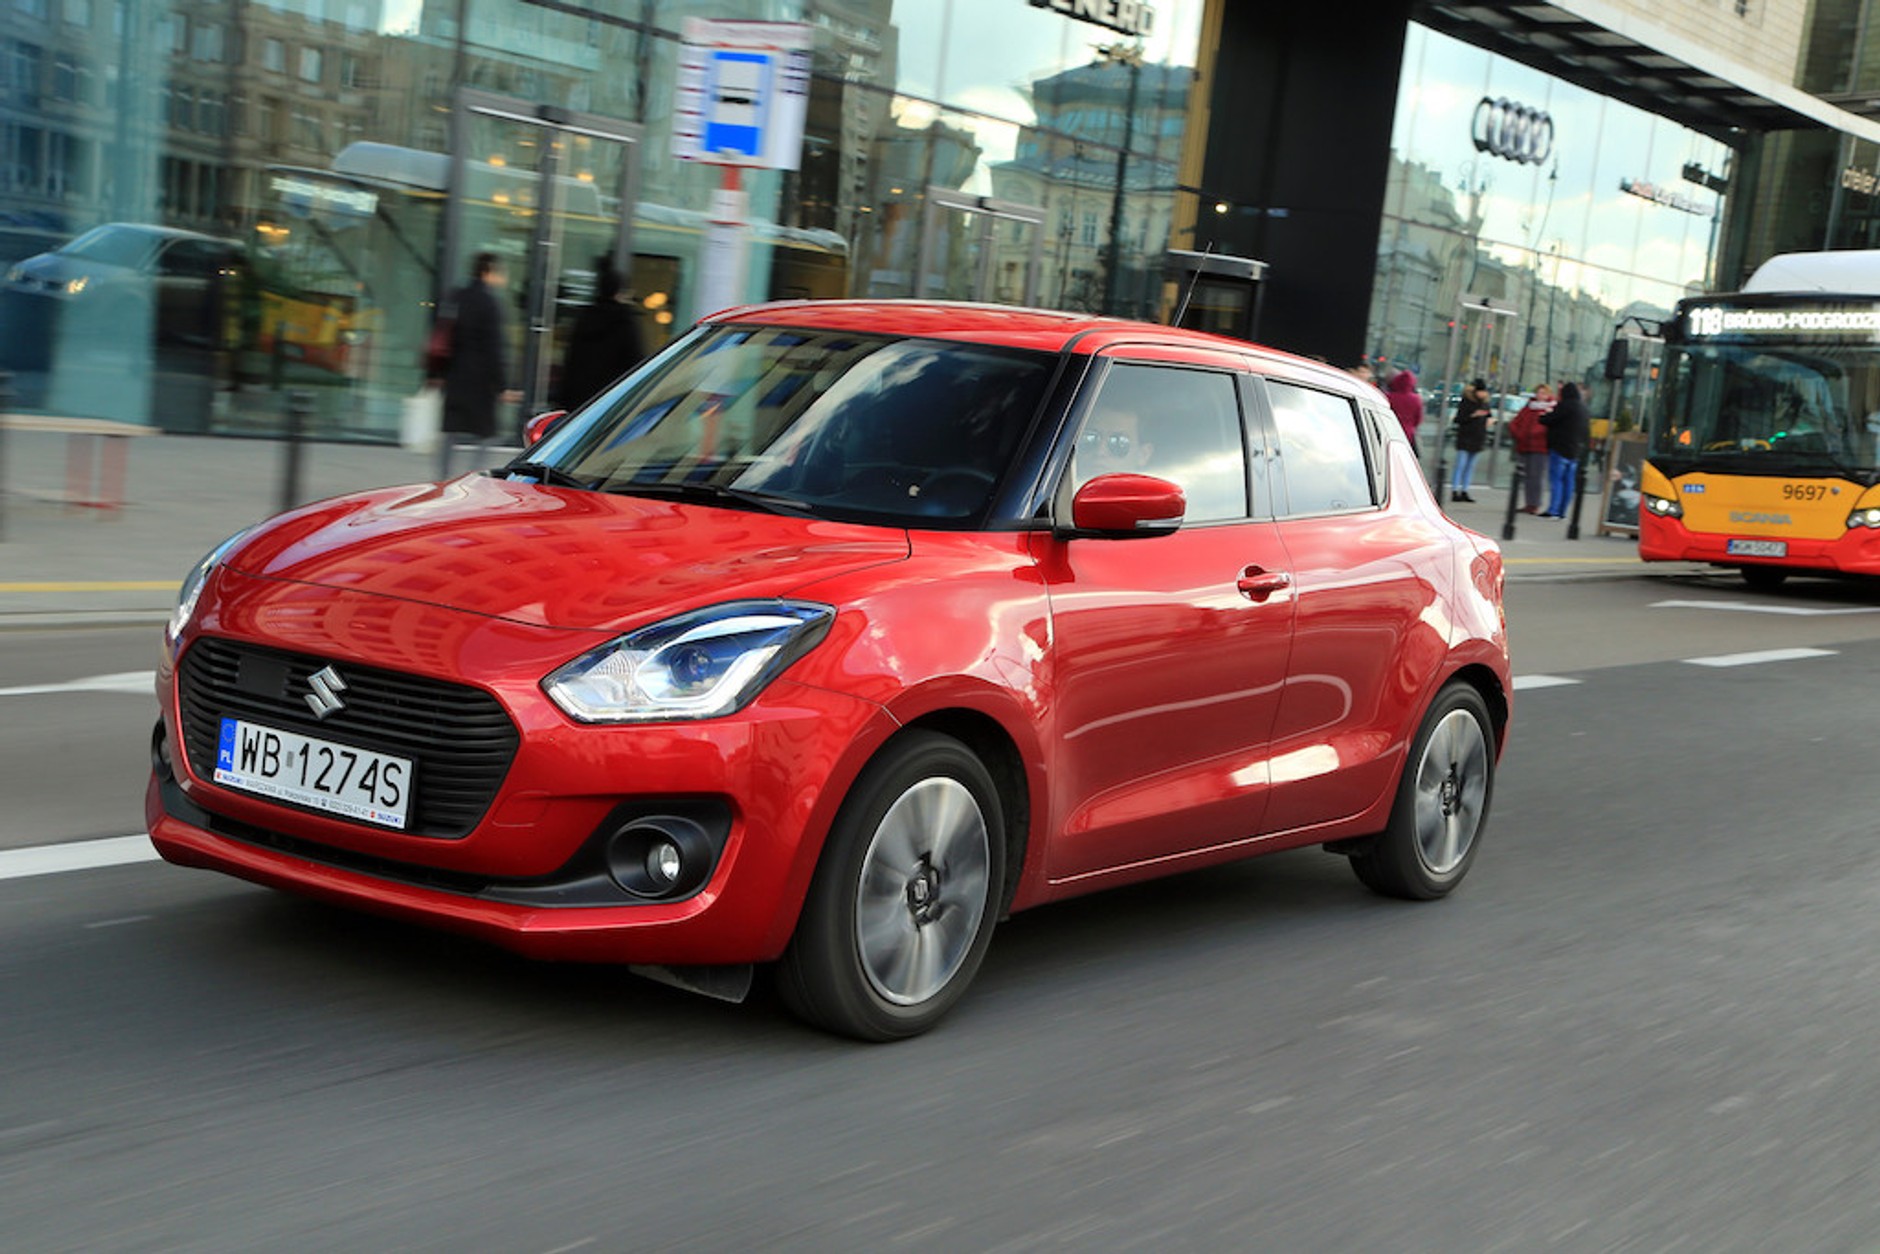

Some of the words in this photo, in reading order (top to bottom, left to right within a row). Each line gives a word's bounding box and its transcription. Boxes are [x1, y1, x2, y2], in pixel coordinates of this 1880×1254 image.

[1689, 307, 1723, 335] 118
[1783, 485, 1826, 501] 9697
[1729, 511, 1792, 525] SCANIA
[220, 750, 233, 764] PL
[241, 727, 281, 777] WB
[299, 742, 402, 808] 1274S
